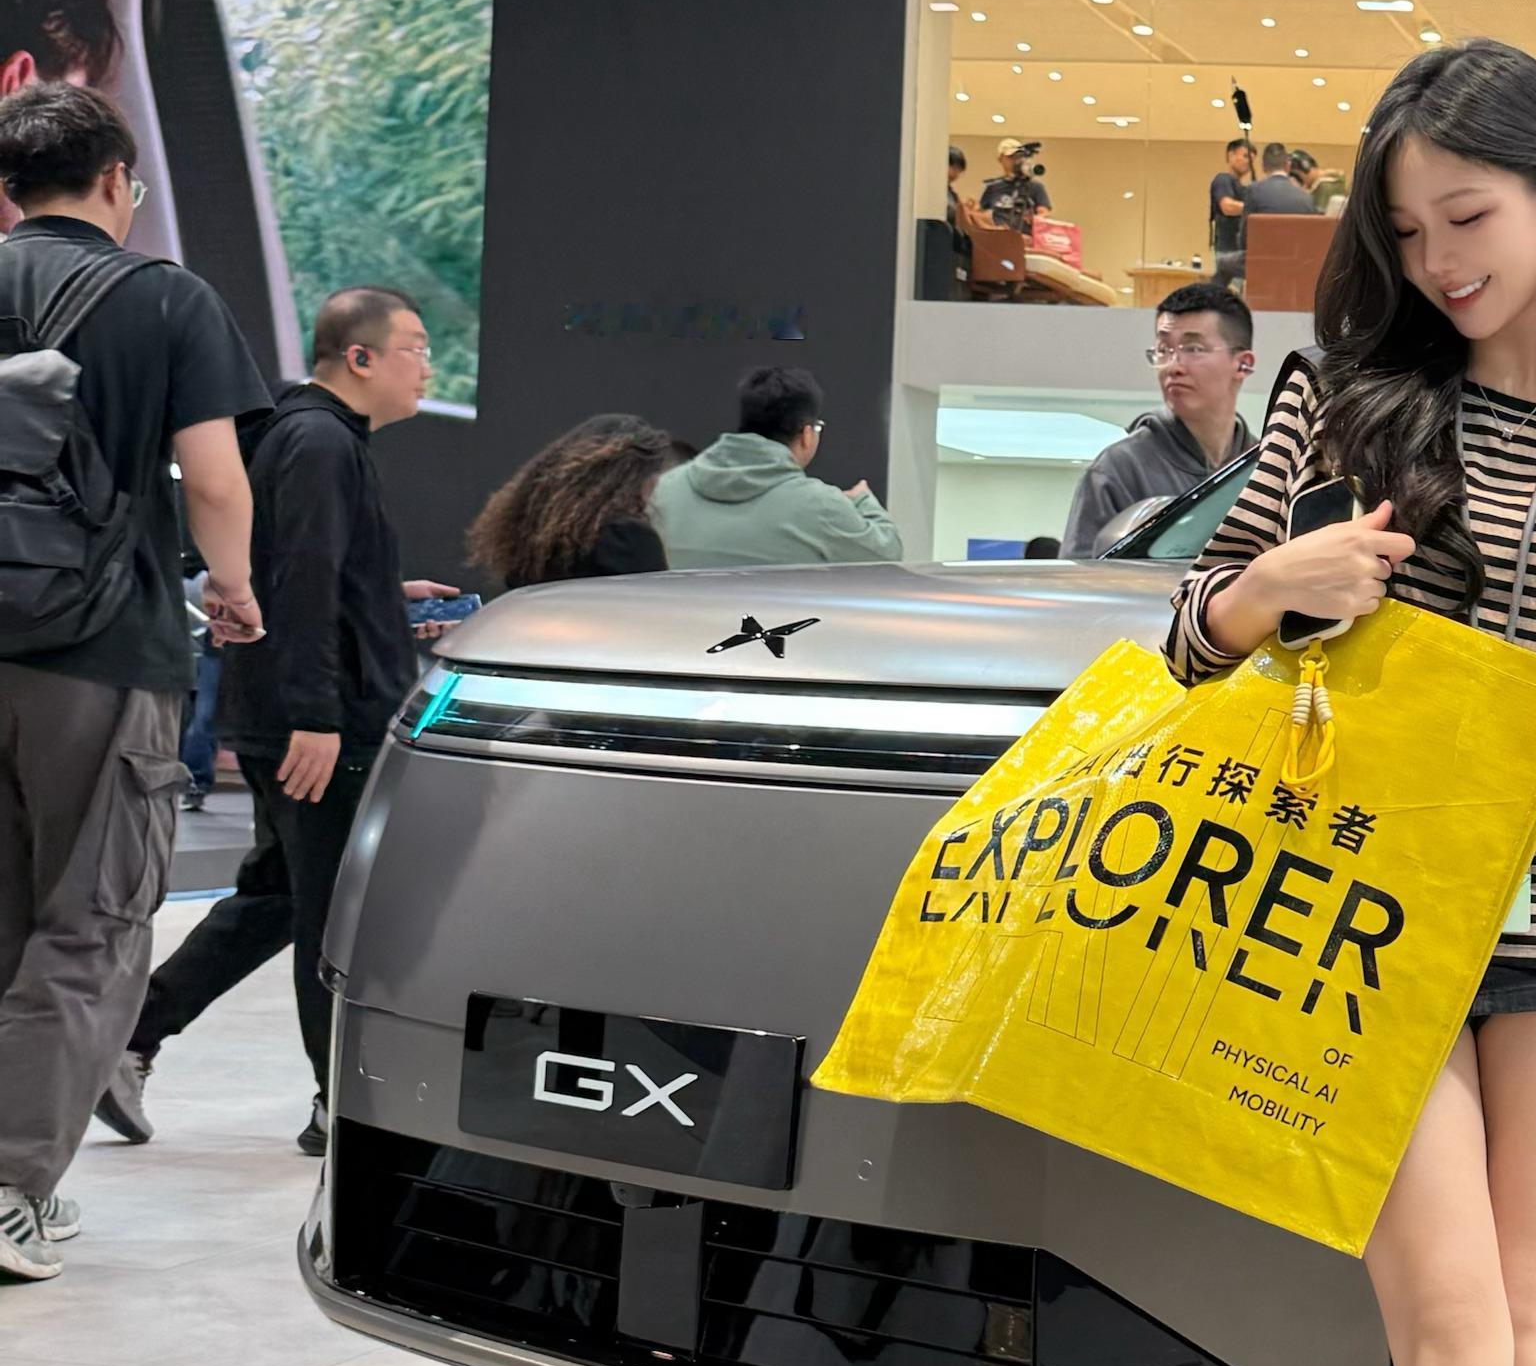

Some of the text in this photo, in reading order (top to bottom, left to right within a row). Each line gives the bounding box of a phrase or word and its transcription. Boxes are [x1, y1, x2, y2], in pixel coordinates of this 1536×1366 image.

[931, 796, 1405, 990] EXPLORER
[534, 1051, 698, 1126] GX
[1211, 1040, 1338, 1104] PHYSICAL AI
[1323, 1047, 1353, 1068] OF
[1228, 1086, 1326, 1136] MOBILITY
